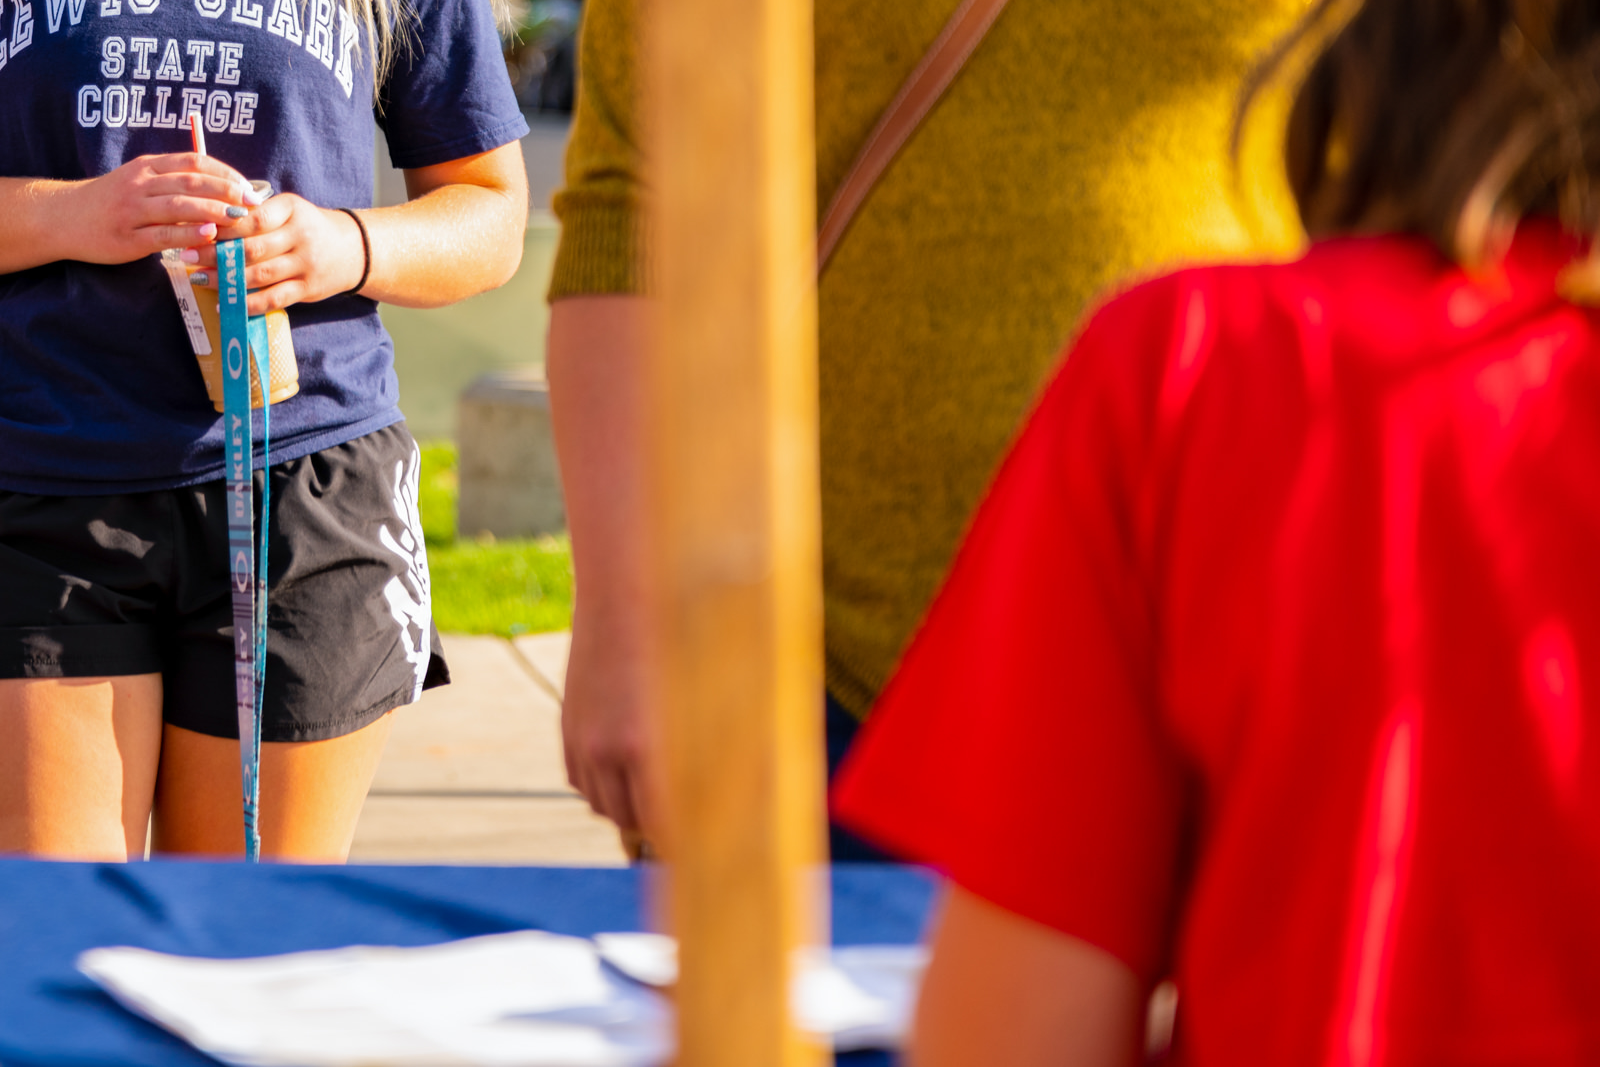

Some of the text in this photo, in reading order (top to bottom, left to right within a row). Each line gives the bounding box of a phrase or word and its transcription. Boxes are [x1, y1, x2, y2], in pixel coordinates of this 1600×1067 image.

[101, 36, 244, 86] STATE
[77, 84, 259, 135] COLLEGE
[231, 413, 245, 518] OAKLEY
